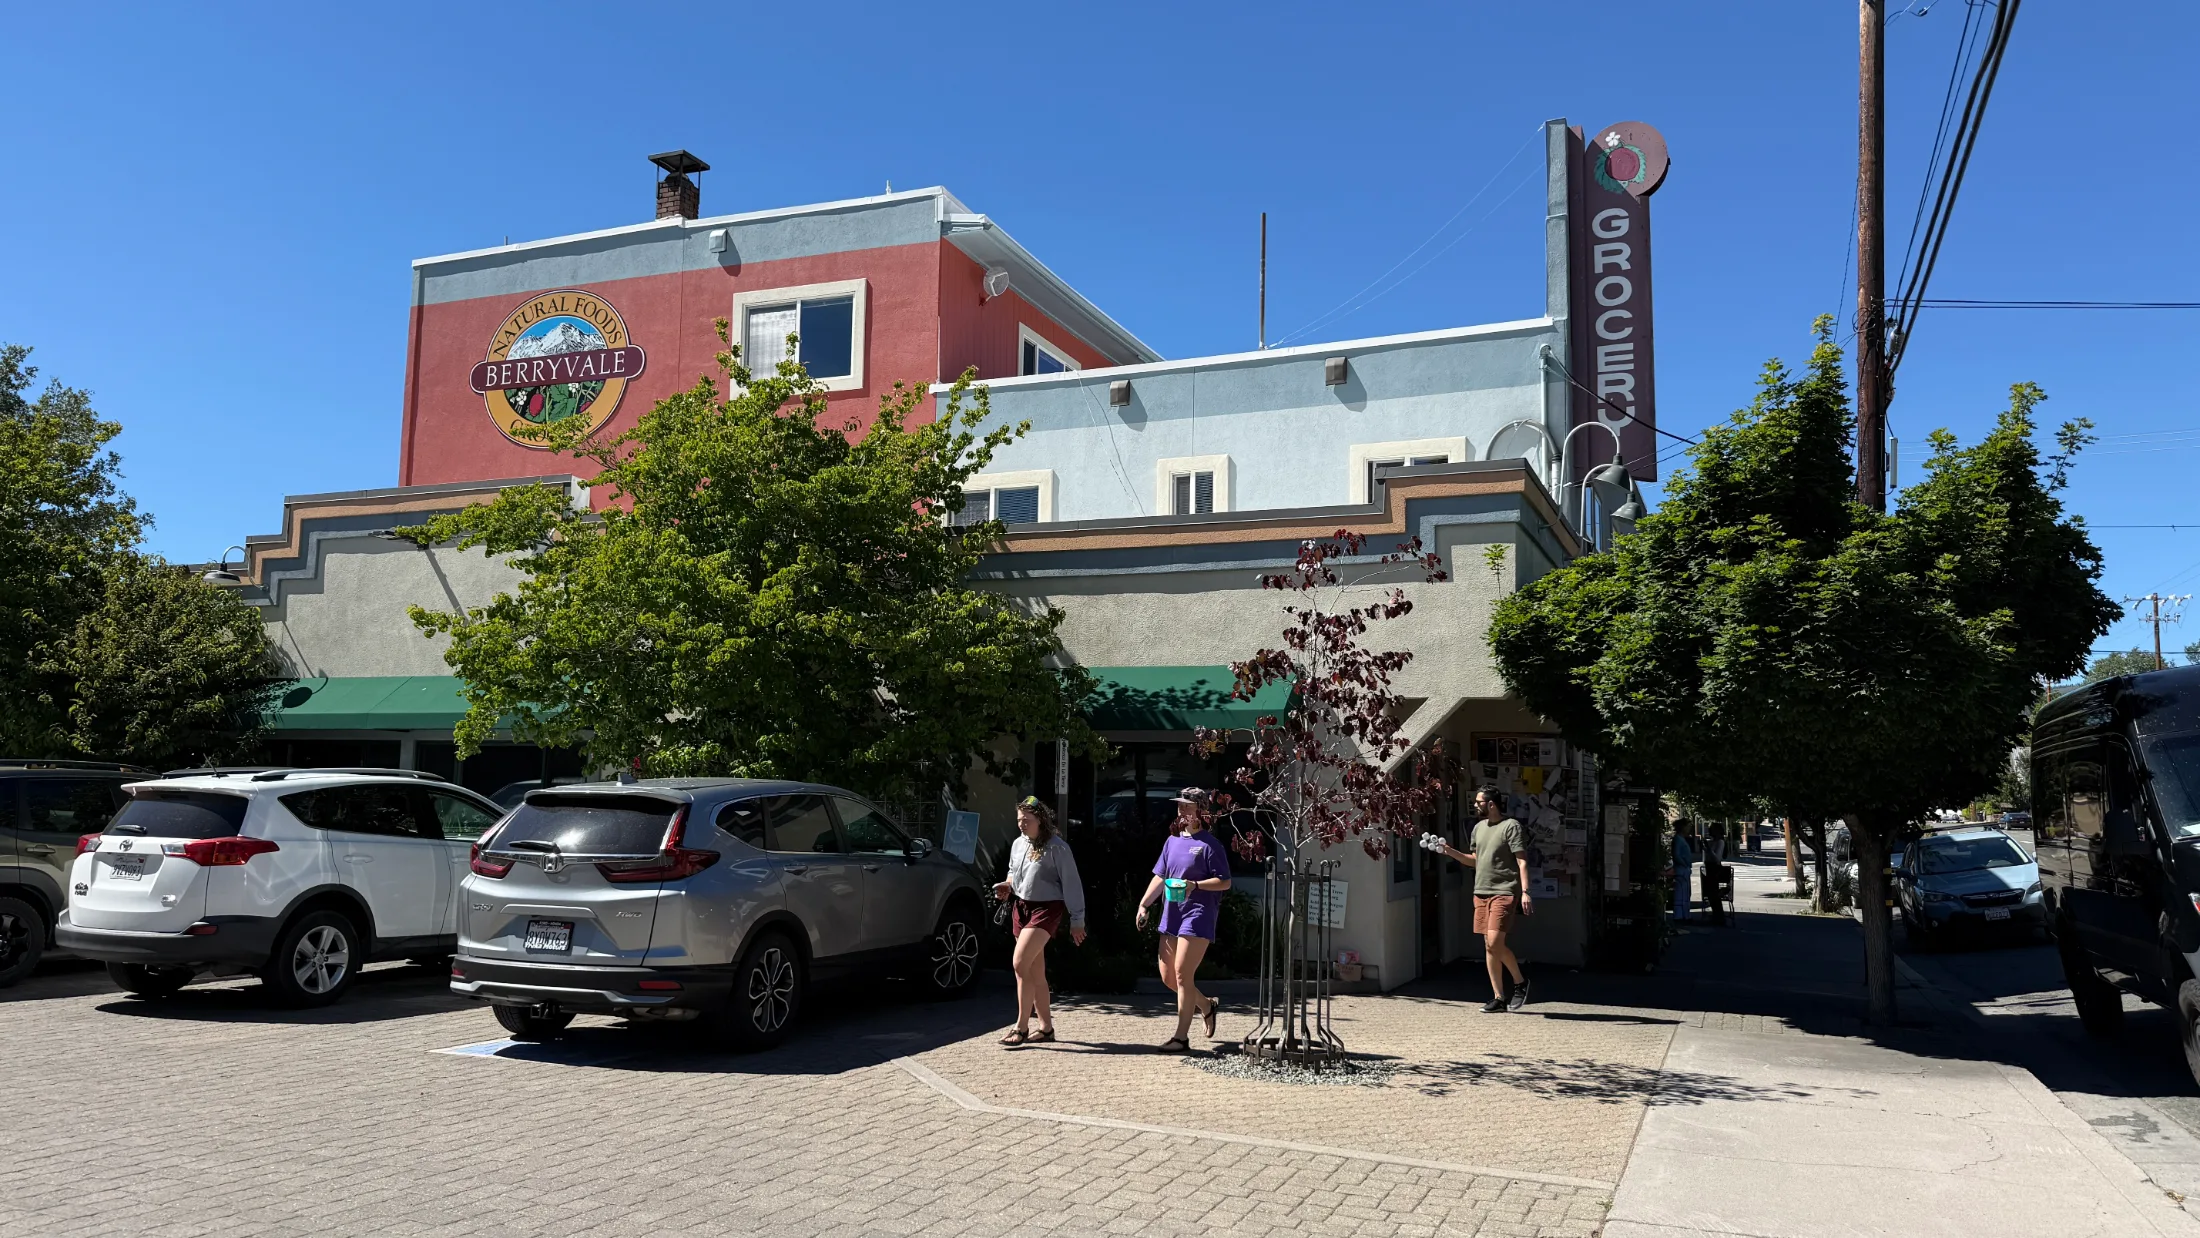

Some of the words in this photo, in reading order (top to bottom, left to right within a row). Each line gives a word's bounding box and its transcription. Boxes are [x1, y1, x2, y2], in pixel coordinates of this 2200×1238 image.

[493, 296, 570, 358] NATURAL
[574, 297, 623, 344] FOODS
[1592, 208, 1635, 437] GROCERY
[485, 350, 626, 387] BERRYVALE
